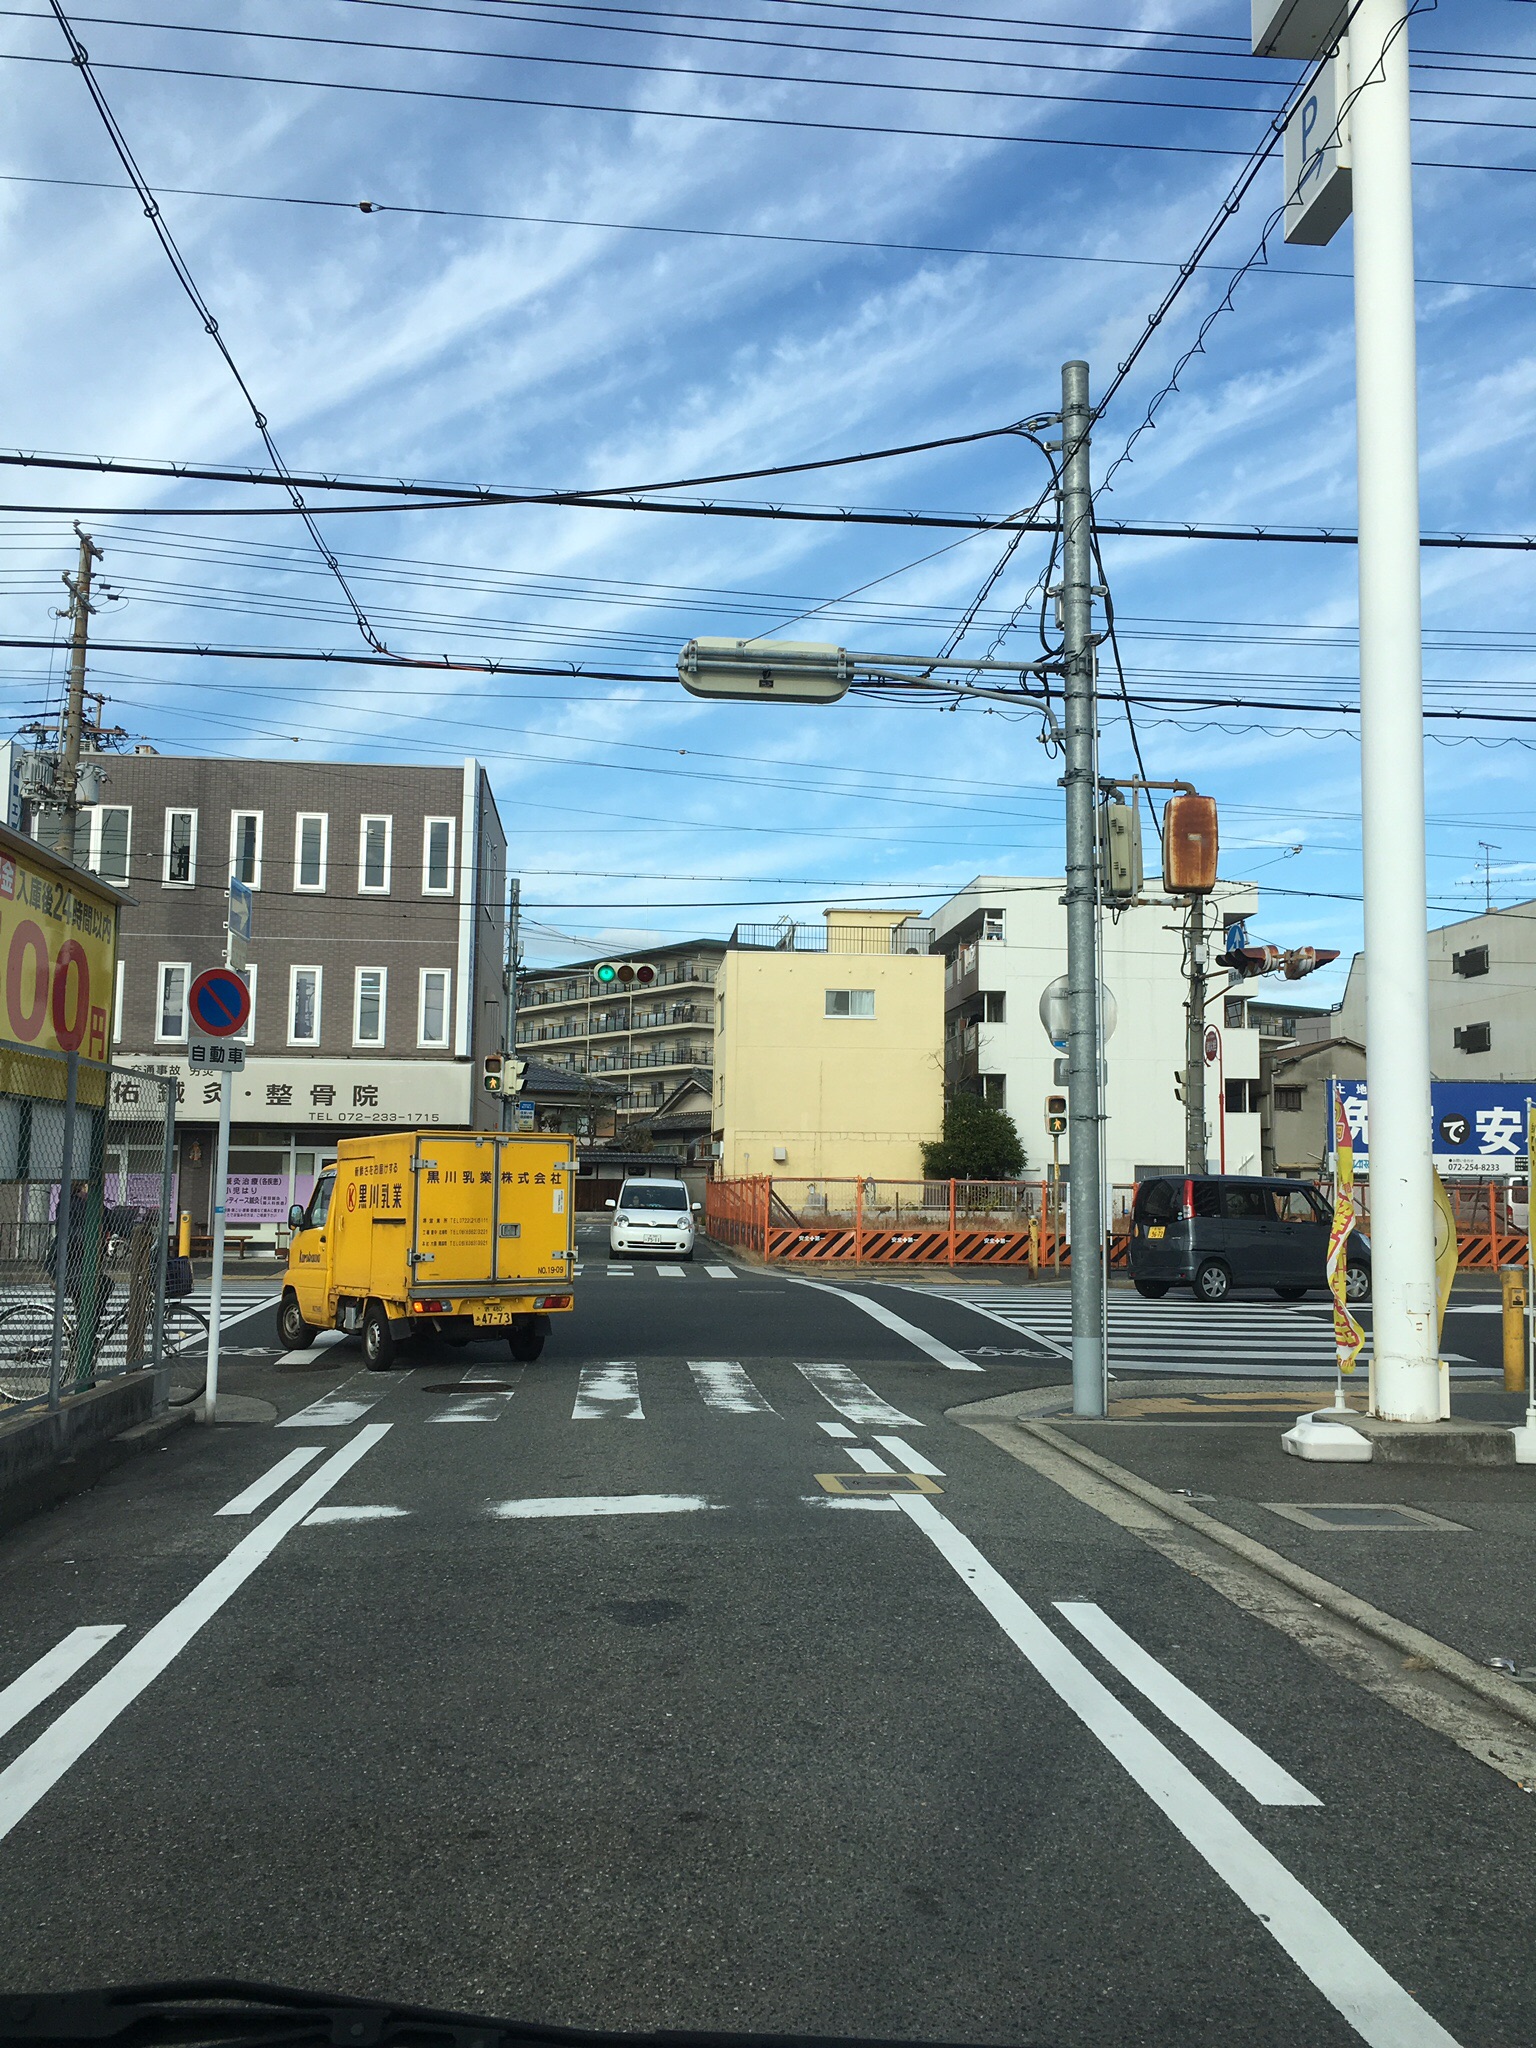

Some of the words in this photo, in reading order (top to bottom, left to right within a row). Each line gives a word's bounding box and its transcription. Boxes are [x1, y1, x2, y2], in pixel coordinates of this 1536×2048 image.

[1303, 95, 1318, 163] P
[0, 857, 14, 894] 金
[17, 869, 112, 944] 入庫後24時間以内
[0, 911, 107, 1060] 00円
[191, 1045, 243, 1064] 自動車
[309, 1112, 333, 1121] TEL
[338, 1112, 440, 1122] 072-233-1715
[1448, 1163, 1500, 1172] 072-254-8233
[427, 1171, 562, 1185] 黒川乳業株式会社
[358, 1183, 402, 1208] 黒川乳業
[538, 1266, 564, 1275] NO.19-09
[482, 1312, 511, 1323] 47-73
